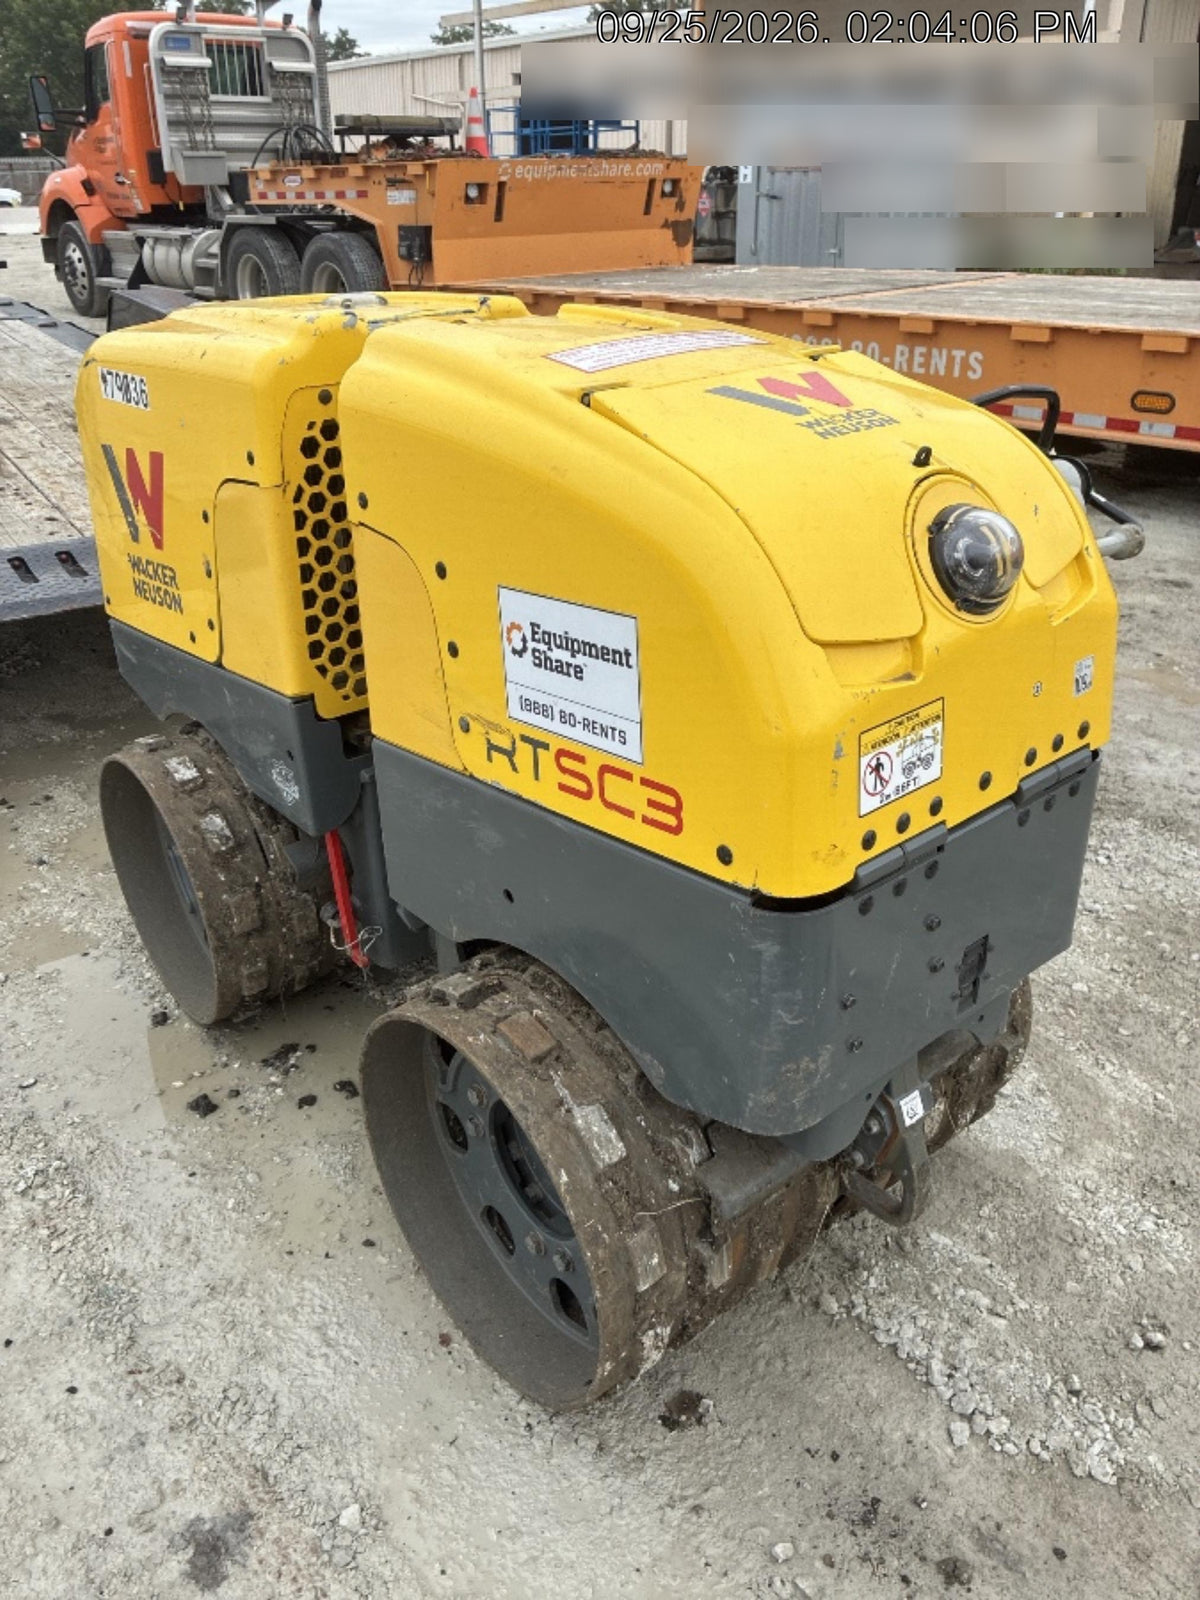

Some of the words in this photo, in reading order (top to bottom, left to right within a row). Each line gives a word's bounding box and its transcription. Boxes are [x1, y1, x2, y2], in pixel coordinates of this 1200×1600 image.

[127, 552, 180, 591] WACKER
[133, 577, 184, 616] NEUSON
[529, 621, 633, 669] Equipment
[531, 647, 584, 682] Share
